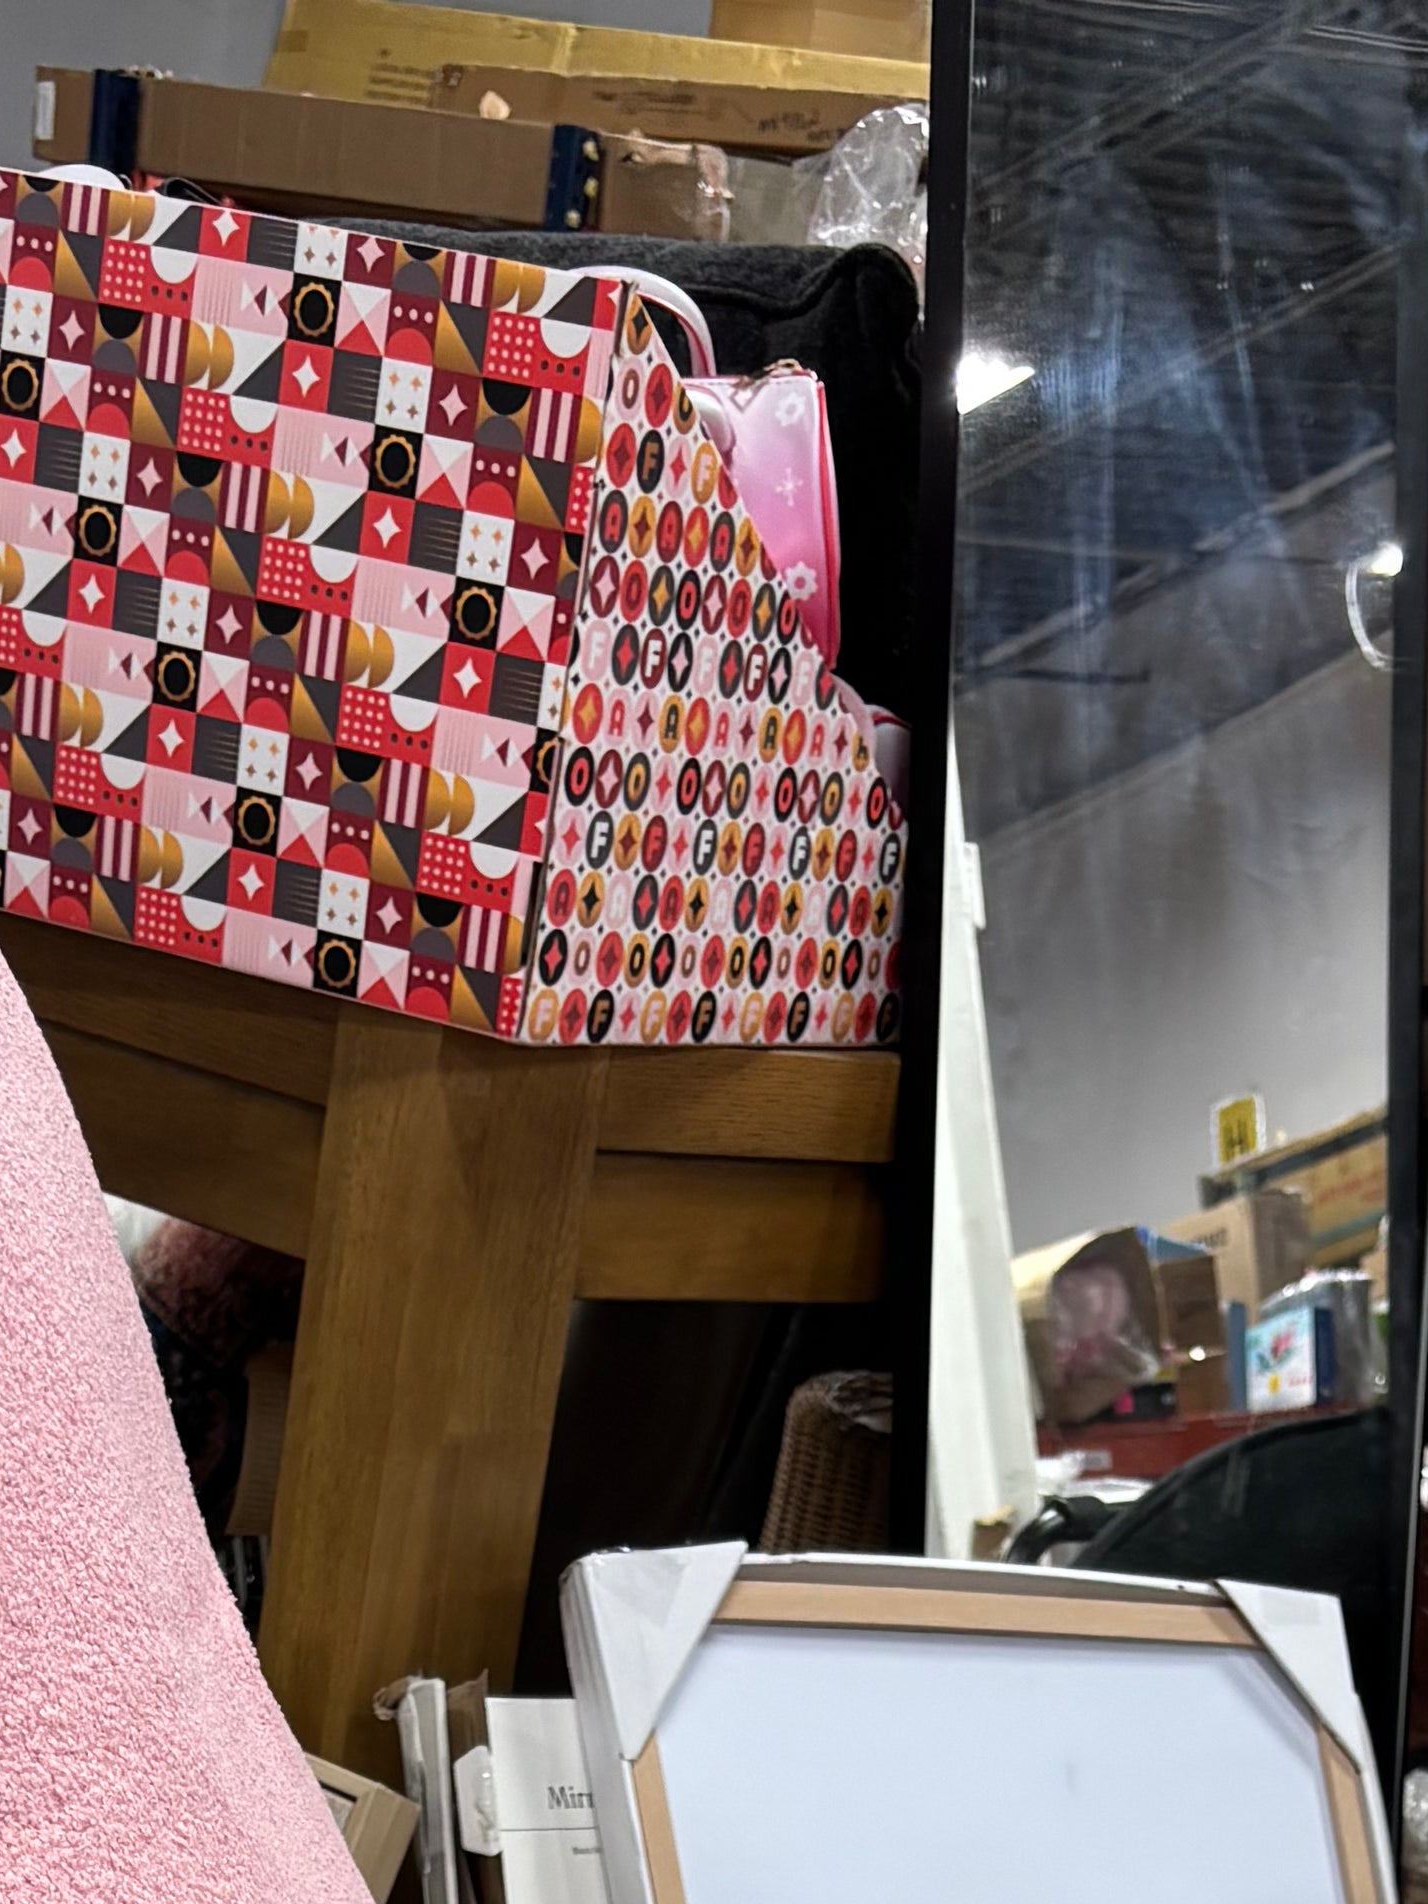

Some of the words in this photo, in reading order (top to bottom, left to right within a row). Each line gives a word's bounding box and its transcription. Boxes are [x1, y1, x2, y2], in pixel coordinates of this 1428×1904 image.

[643, 442, 658, 480] F
[697, 455, 714, 492] F
[589, 631, 605, 669] F
[645, 640, 662, 677] F
[747, 654, 764, 691] F
[608, 699, 625, 737] A
[664, 704, 679, 739] A
[764, 716, 777, 750] A
[591, 822, 608, 858] F
[698, 830, 713, 865] F
[793, 836, 808, 871] F
[883, 841, 897, 876] F
[536, 998, 553, 1034] F
[592, 1001, 609, 1034] F
[696, 1001, 713, 1034] F
[791, 1001, 805, 1034] F
